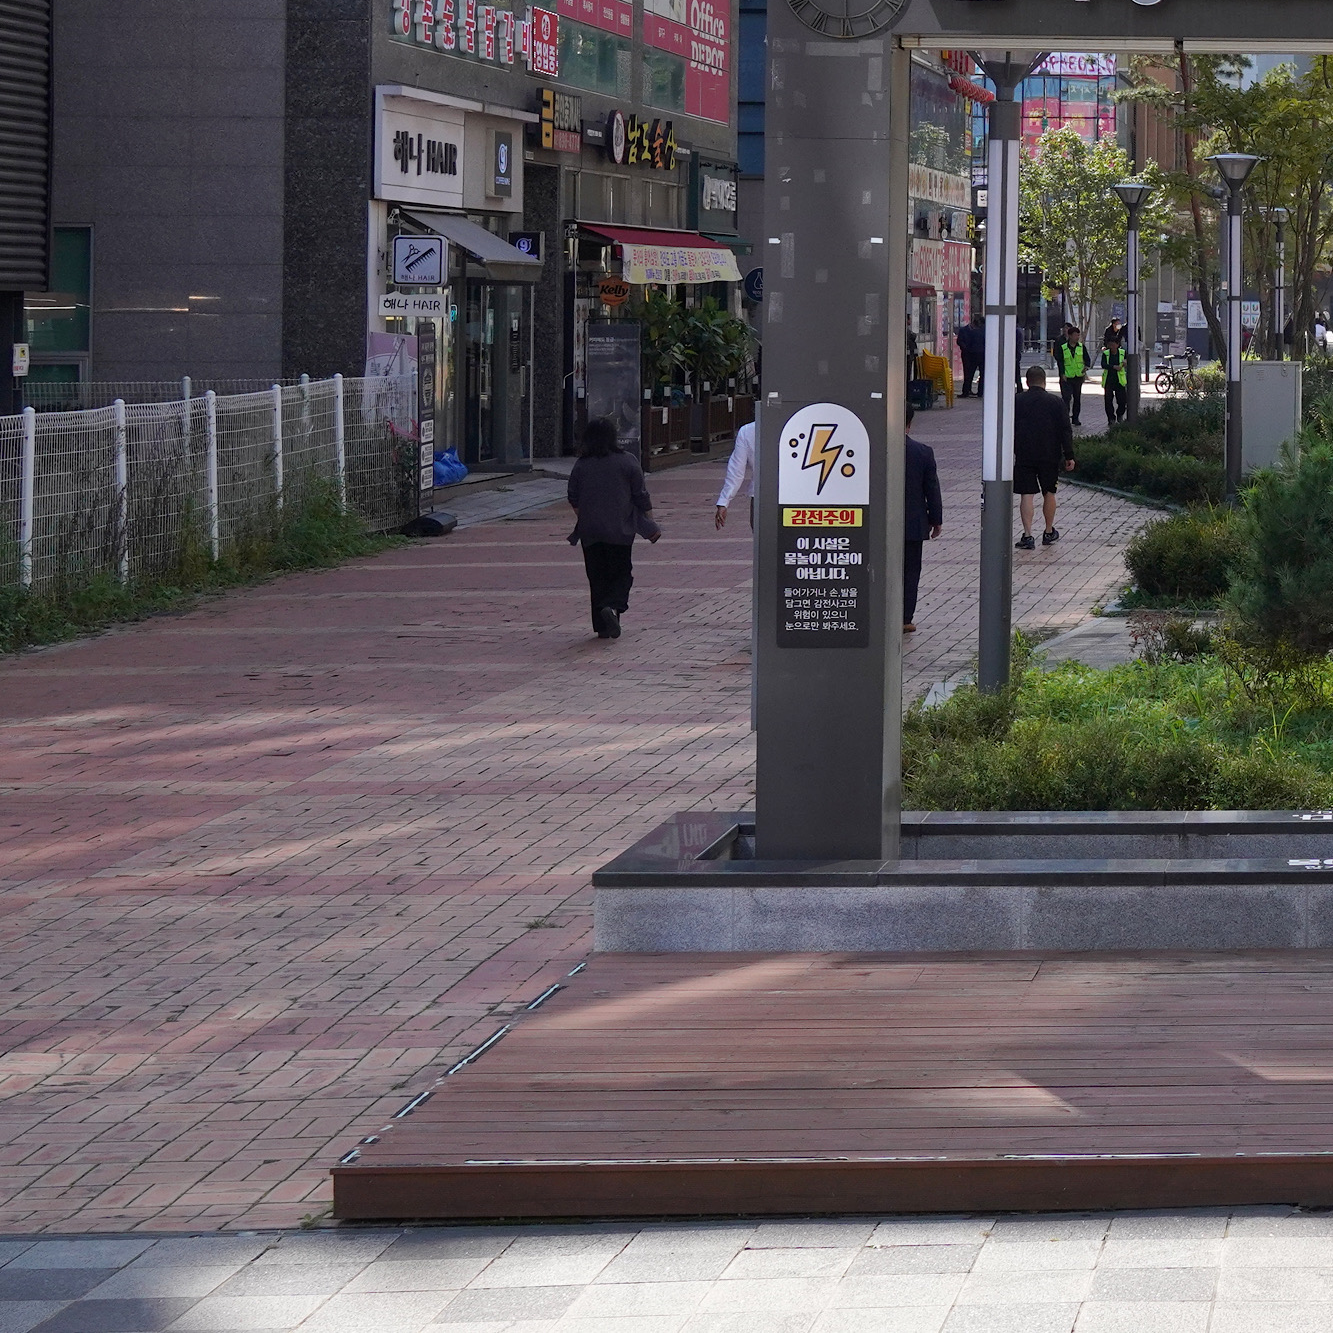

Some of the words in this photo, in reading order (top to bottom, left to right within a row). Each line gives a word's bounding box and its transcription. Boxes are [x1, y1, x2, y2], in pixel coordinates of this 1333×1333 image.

[691, 40, 724, 76] DEPOT
[628, 115, 676, 170] 남도술상
[393, 130, 424, 175] 해나
[427, 139, 458, 177] HAIR
[417, 274, 435, 283] HAIR
[600, 284, 628, 298] Kelly
[384, 298, 409, 311] 해나
[413, 298, 440, 311] HAIR
[791, 510, 855, 525] 감전주의
[797, 537, 809, 550] 이
[812, 537, 849, 550] 시설은
[784, 552, 821, 565] 물놀이
[825, 552, 862, 565] 시설이
[796, 567, 849, 580] 아닙니다.
[784, 588, 826, 597] 들어가거나
[785, 599, 811, 608] 담그면
[814, 599, 856, 608] 감전사고의
[794, 610, 818, 620] 위험이
[823, 610, 847, 620] 있으니
[785, 621, 819, 631] 눈으로만
[823, 621, 859, 631] 봐주세요.
